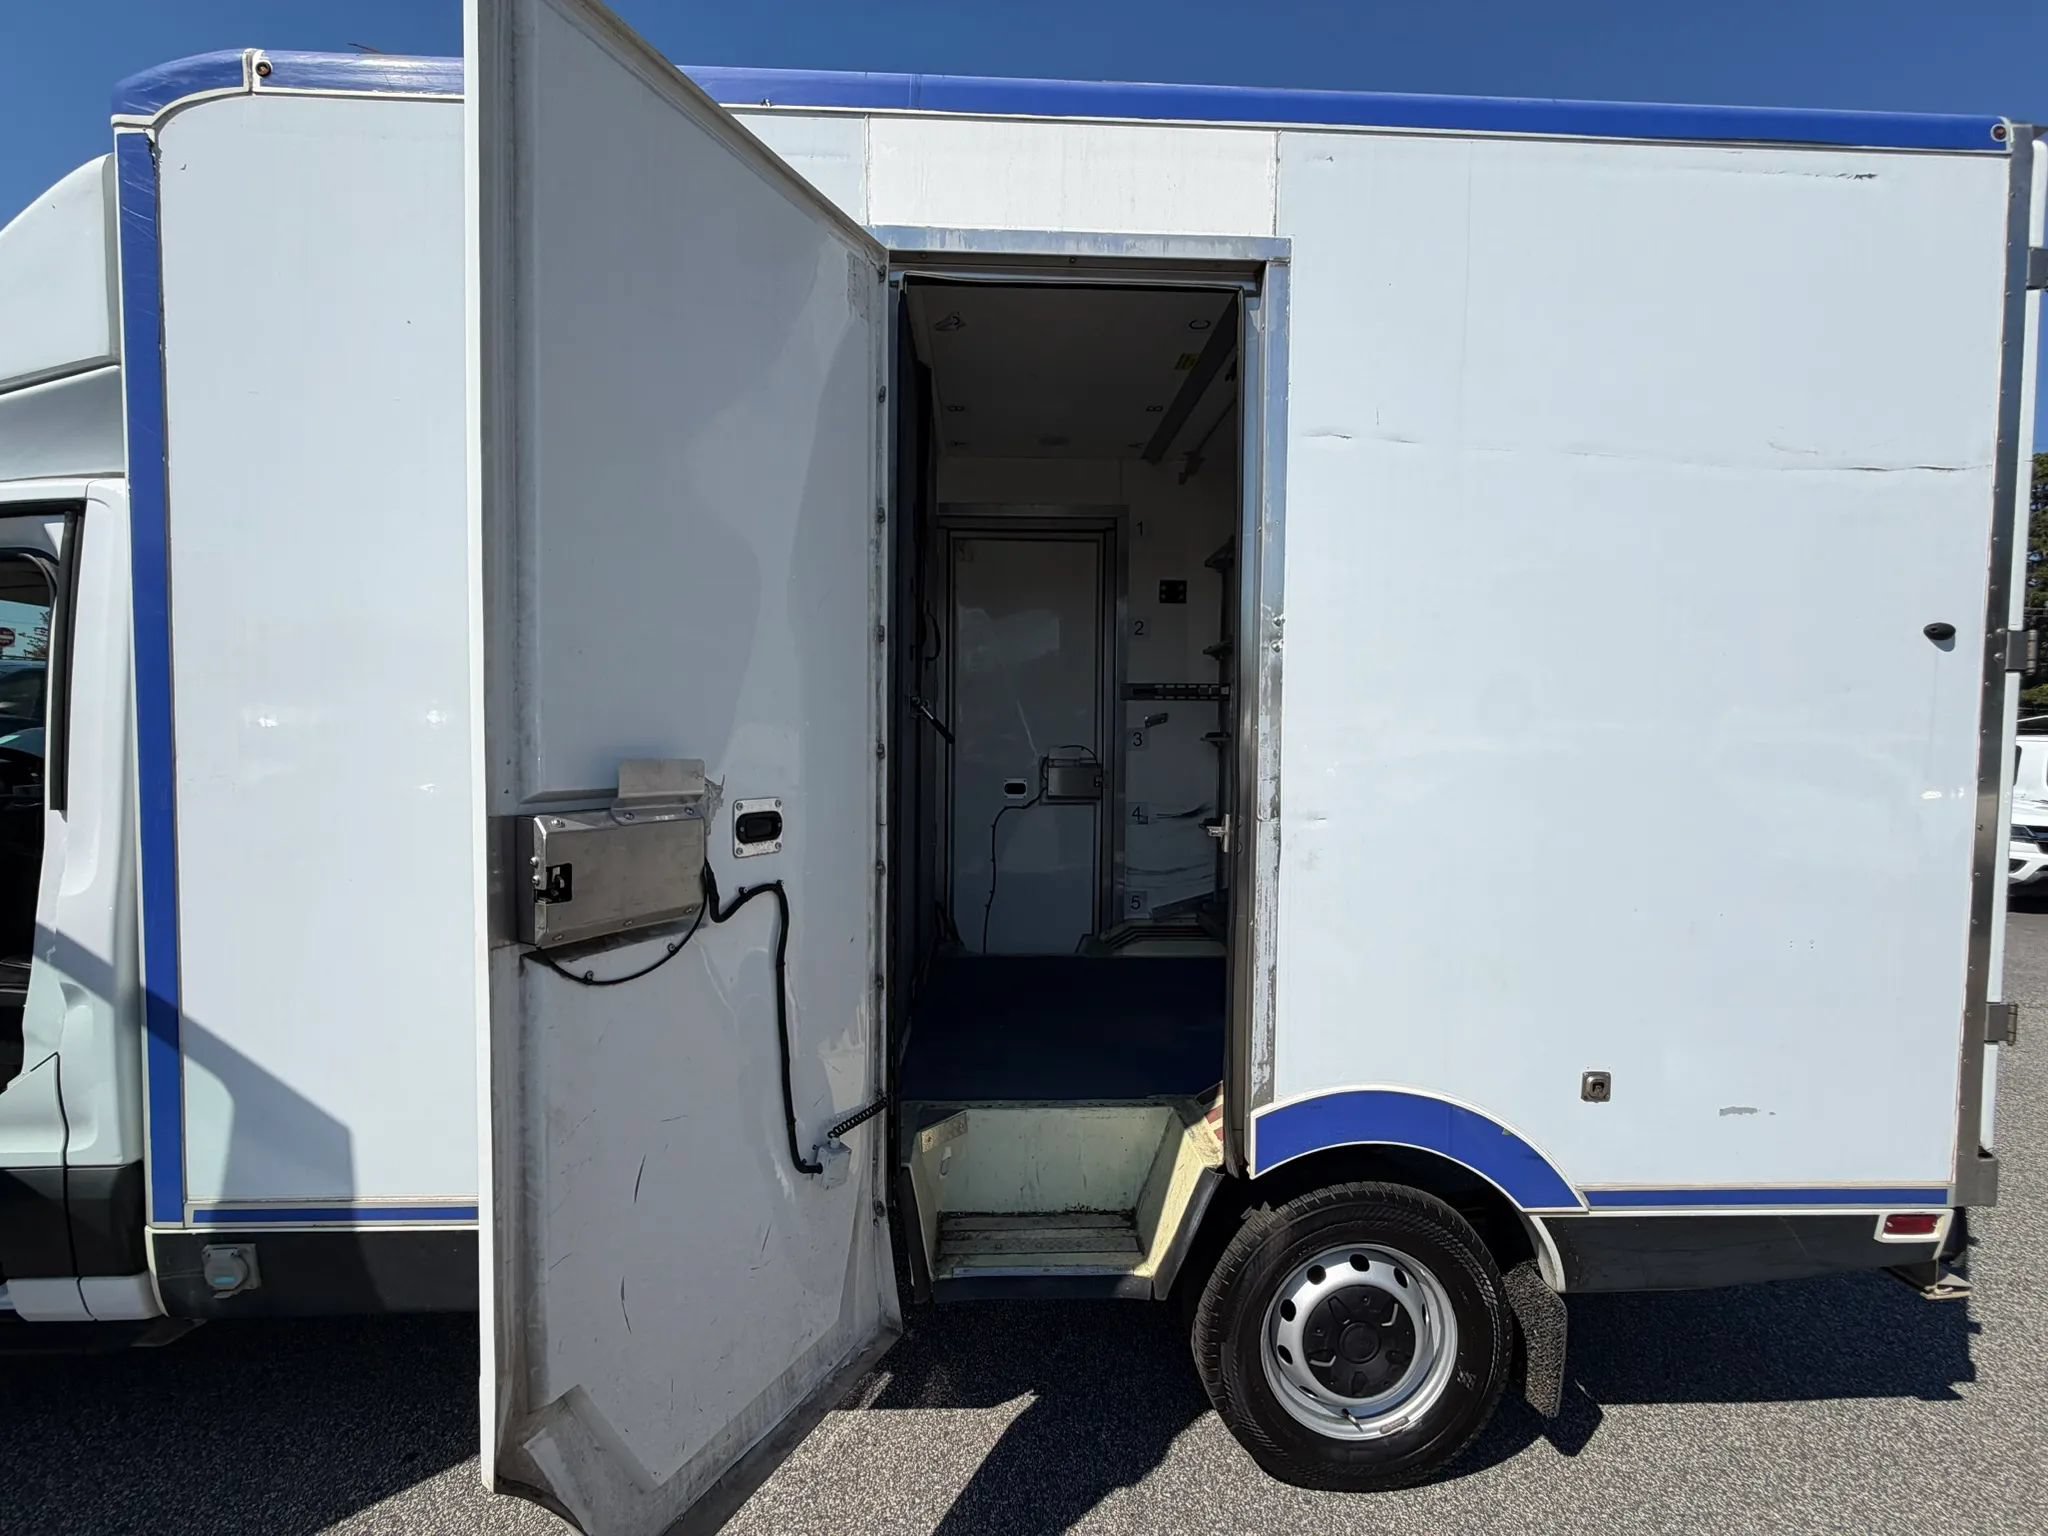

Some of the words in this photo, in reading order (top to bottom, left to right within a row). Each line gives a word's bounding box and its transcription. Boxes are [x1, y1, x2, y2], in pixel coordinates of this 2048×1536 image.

[1135, 520, 1143, 537] 1
[1134, 620, 1145, 636] 2
[1132, 731, 1143, 747] 3
[1131, 805, 1144, 823] 4
[1130, 895, 1141, 910] 5
